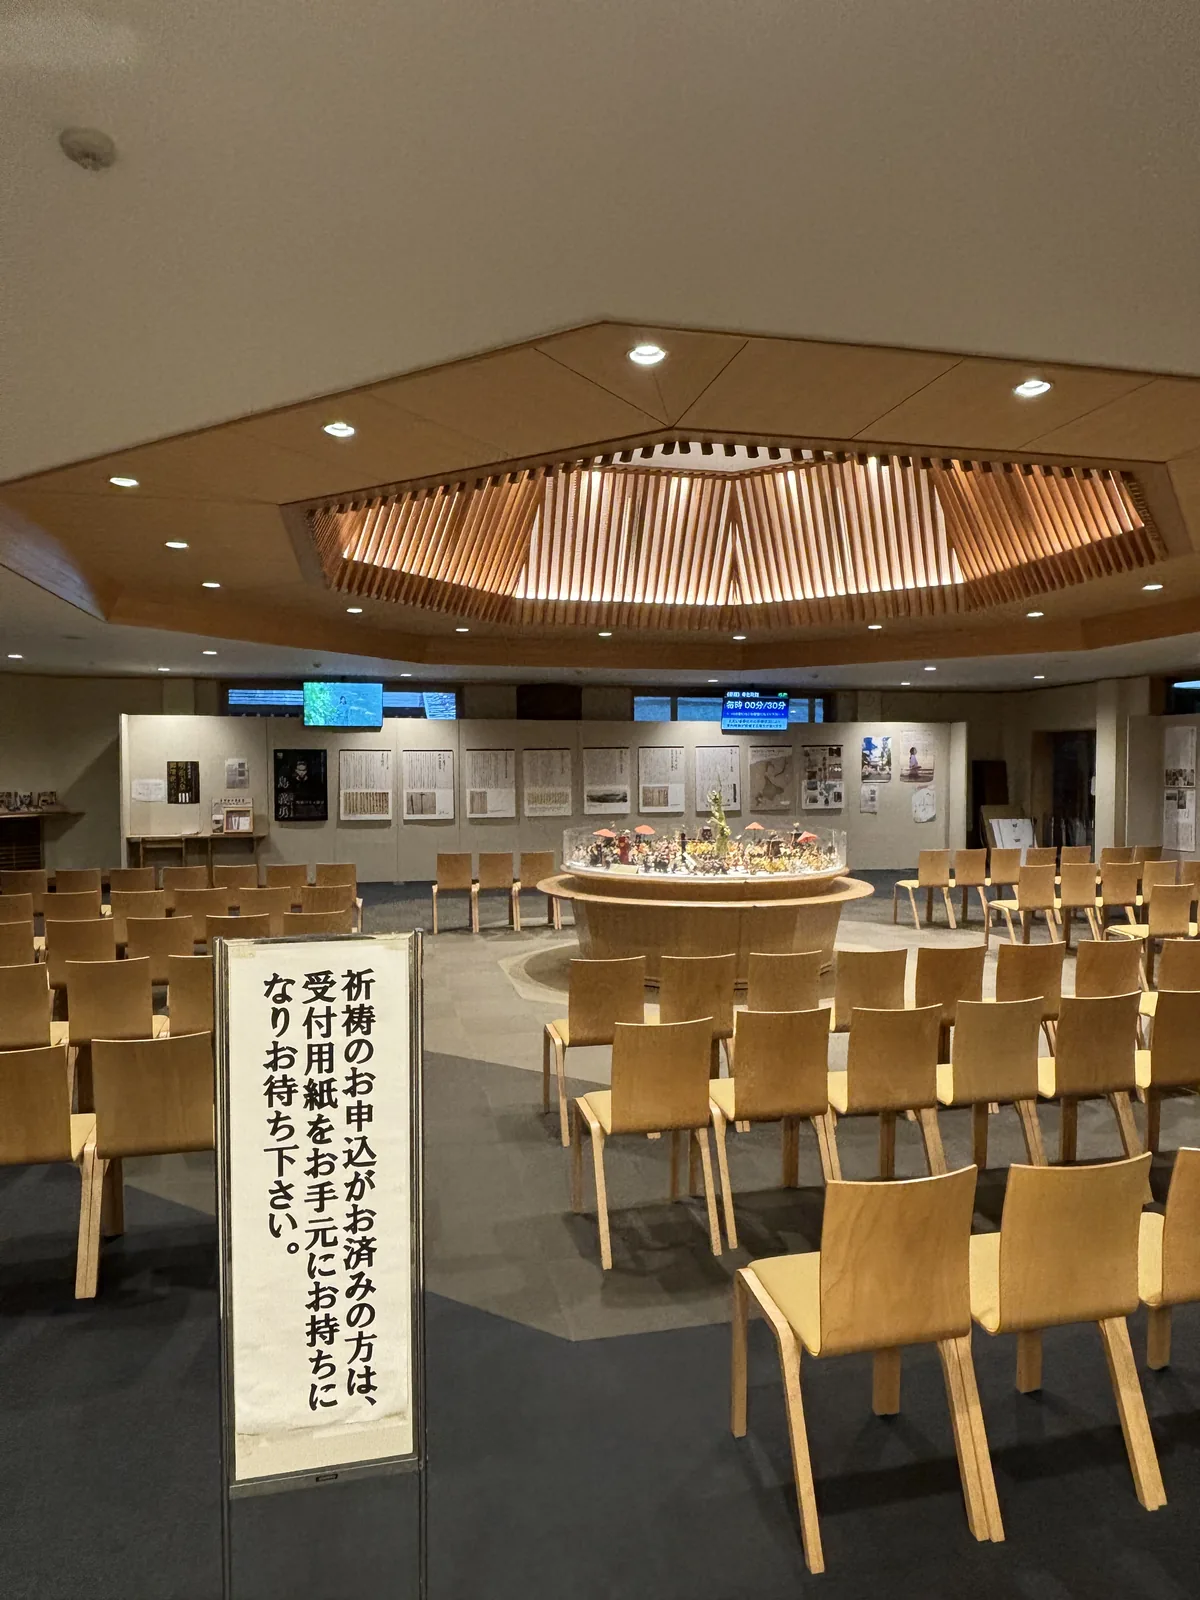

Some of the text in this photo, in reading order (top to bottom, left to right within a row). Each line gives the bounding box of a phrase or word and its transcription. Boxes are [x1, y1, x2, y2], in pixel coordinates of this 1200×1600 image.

[262, 972, 300, 1256] なりお待ち下さい。
[301, 969, 340, 1411] 受付用紙をお手元にお持ちに
[340, 967, 378, 1407] 祈祷のお申込がお済みの方は、
